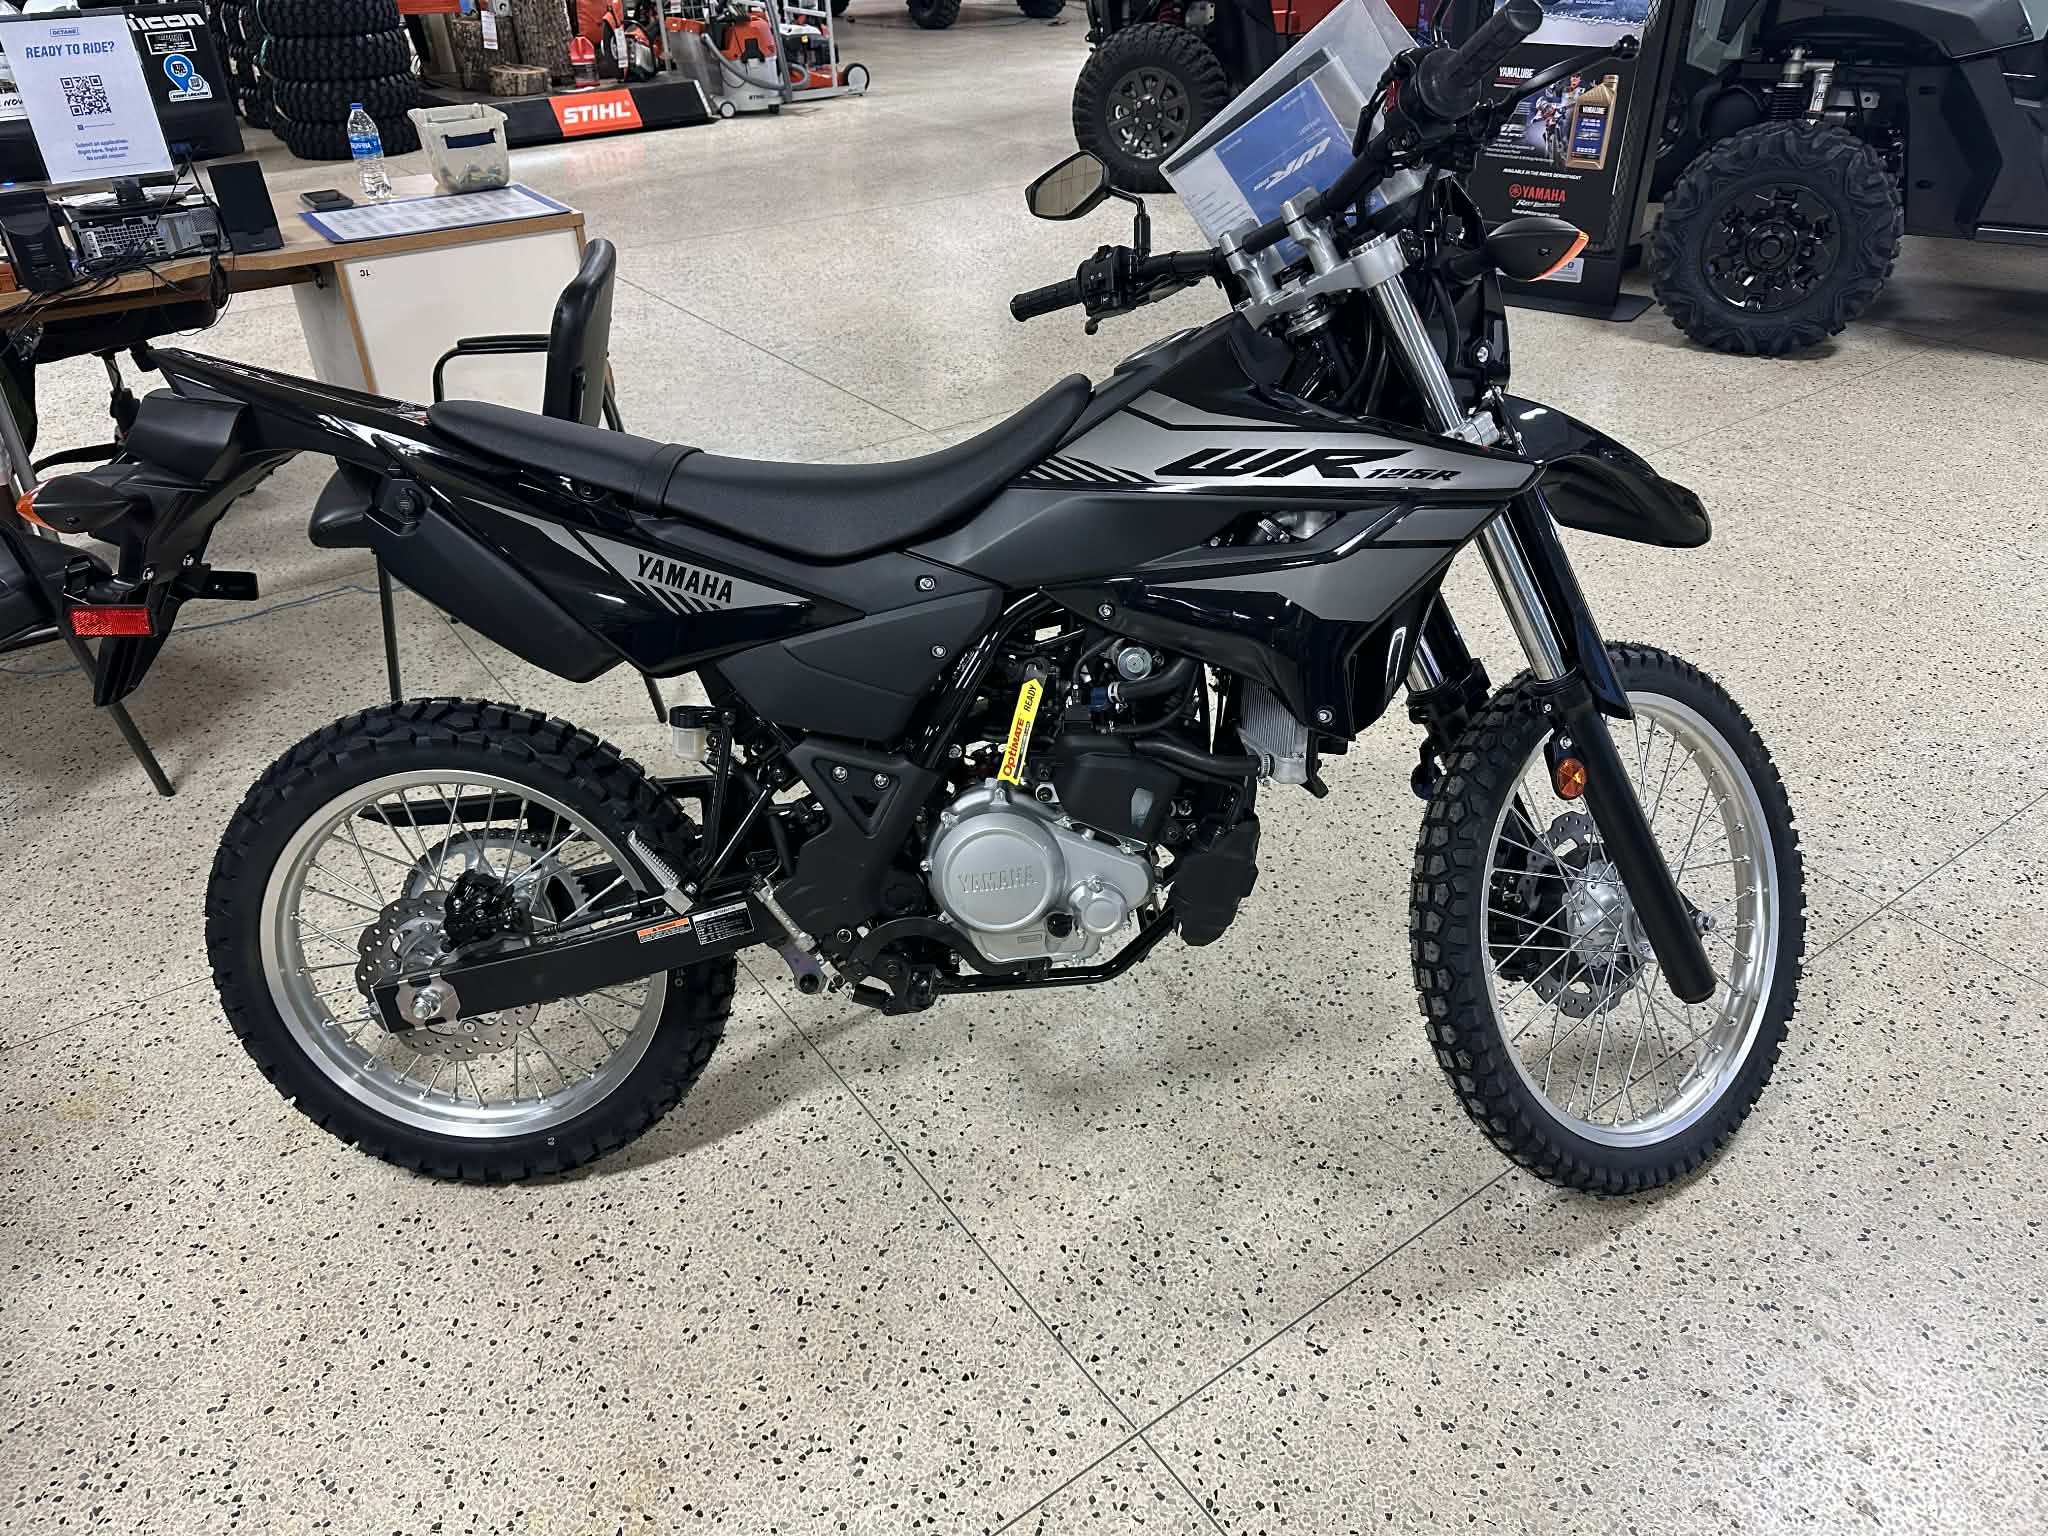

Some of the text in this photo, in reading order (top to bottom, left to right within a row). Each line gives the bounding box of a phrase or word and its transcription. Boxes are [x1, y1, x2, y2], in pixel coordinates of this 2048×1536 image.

[25, 40, 115, 59] READY TO RIDE?
[563, 101, 631, 124] STIHL
[1523, 185, 1566, 203] YAMAHA
[1154, 447, 1462, 481] WR 125R
[637, 553, 732, 604] YAMAHA
[1023, 684, 1037, 712] READY
[959, 864, 1040, 893] YAMAHA
